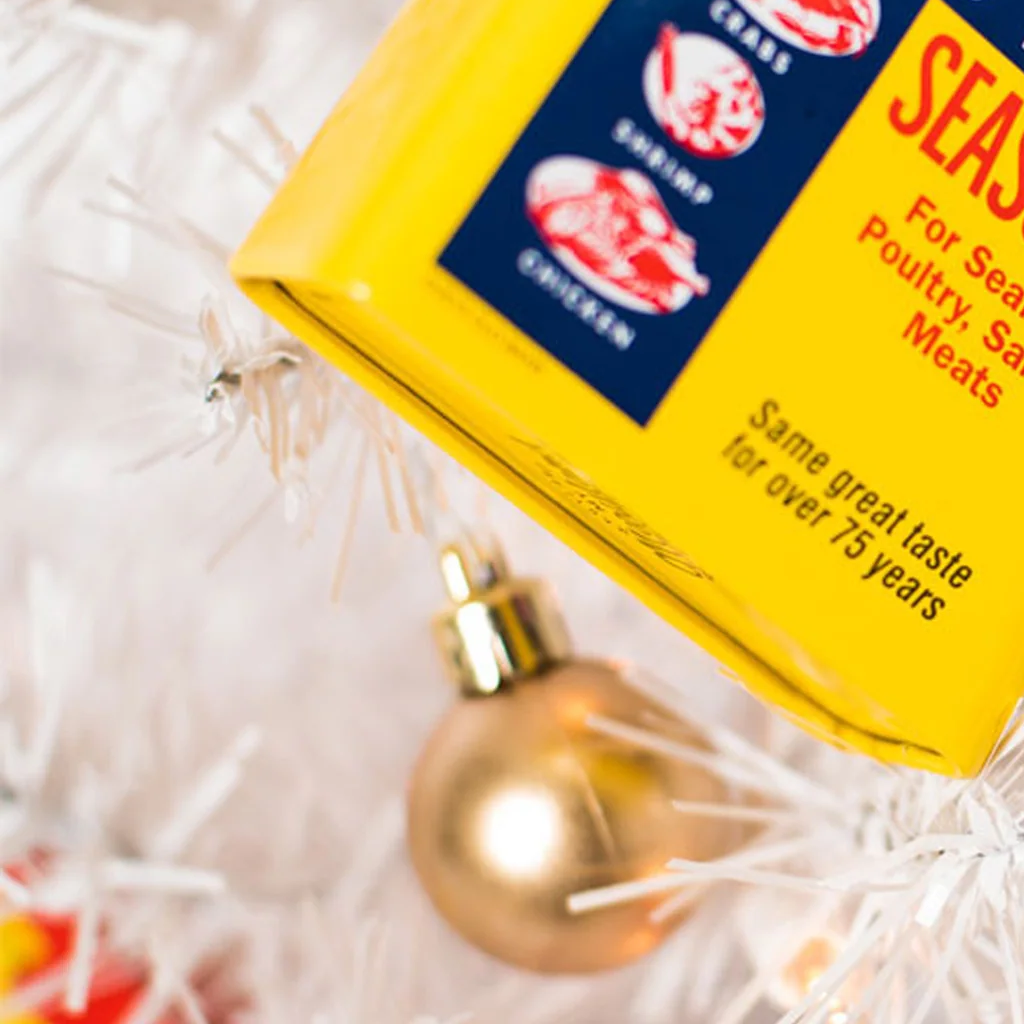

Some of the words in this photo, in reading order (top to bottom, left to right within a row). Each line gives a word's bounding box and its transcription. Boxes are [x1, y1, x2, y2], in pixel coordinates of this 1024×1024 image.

[611, 117, 714, 204] SHRIMP
[857, 215, 973, 334] Poultry,
[904, 194, 962, 253] For
[901, 311, 1004, 409] Meats
[721, 433, 769, 480] for
[765, 471, 832, 530] over
[829, 515, 875, 561] 75
[861, 551, 947, 621] years
[748, 398, 831, 476] Same
[823, 468, 909, 537] great
[902, 523, 974, 591] taste
